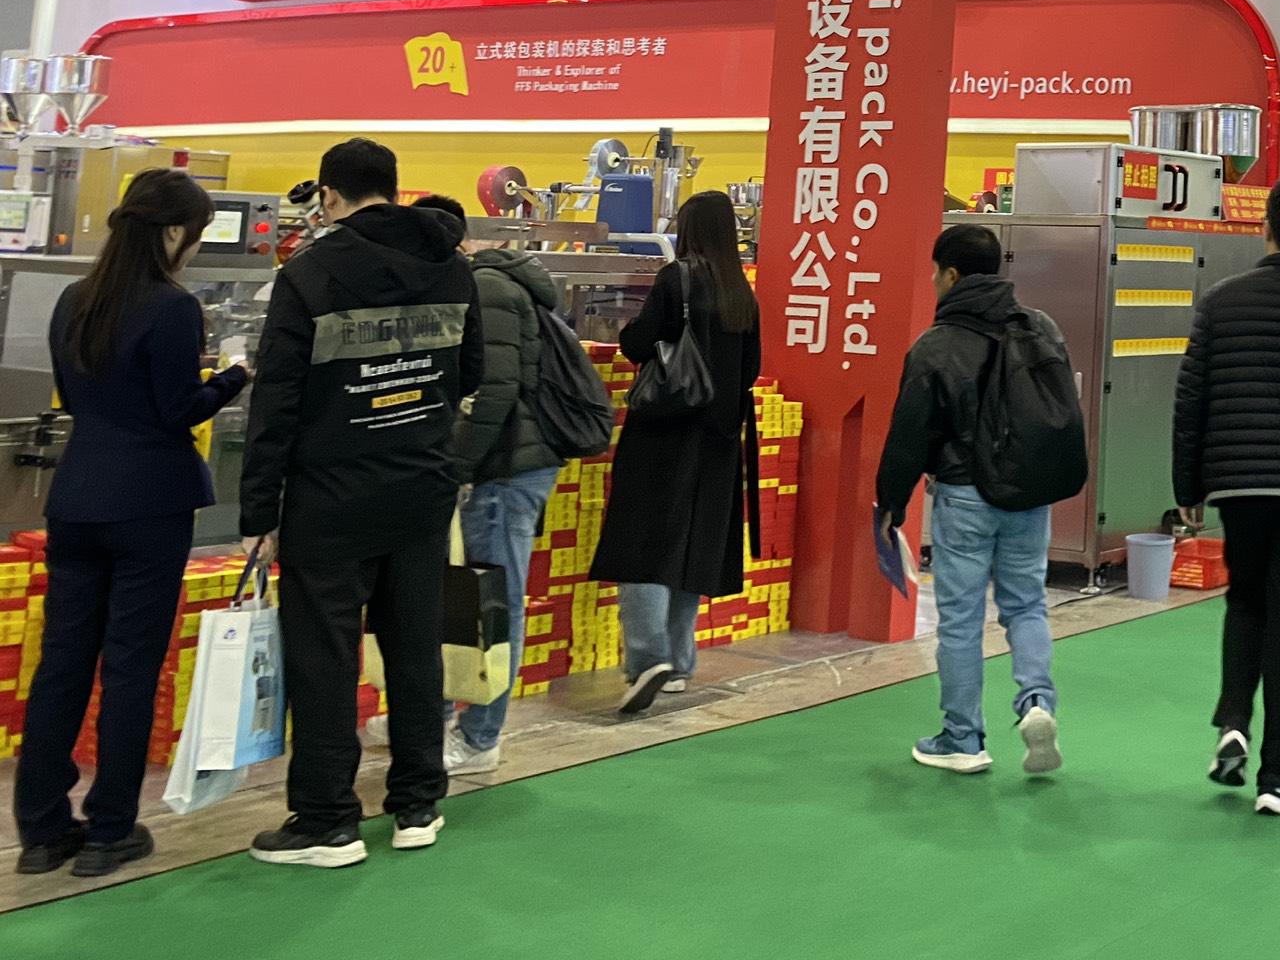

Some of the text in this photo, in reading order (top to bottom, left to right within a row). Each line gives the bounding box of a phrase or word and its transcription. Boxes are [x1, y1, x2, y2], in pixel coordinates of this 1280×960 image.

[474, 36, 668, 60] 立式袋包装机的探索和思考者
[516, 65, 552, 78] Thinker
[564, 65, 605, 78] Explorer
[608, 64, 621, 75] of
[533, 81, 580, 93] Packaging
[581, 81, 619, 91] Machine
[857, 27, 894, 148] pack
